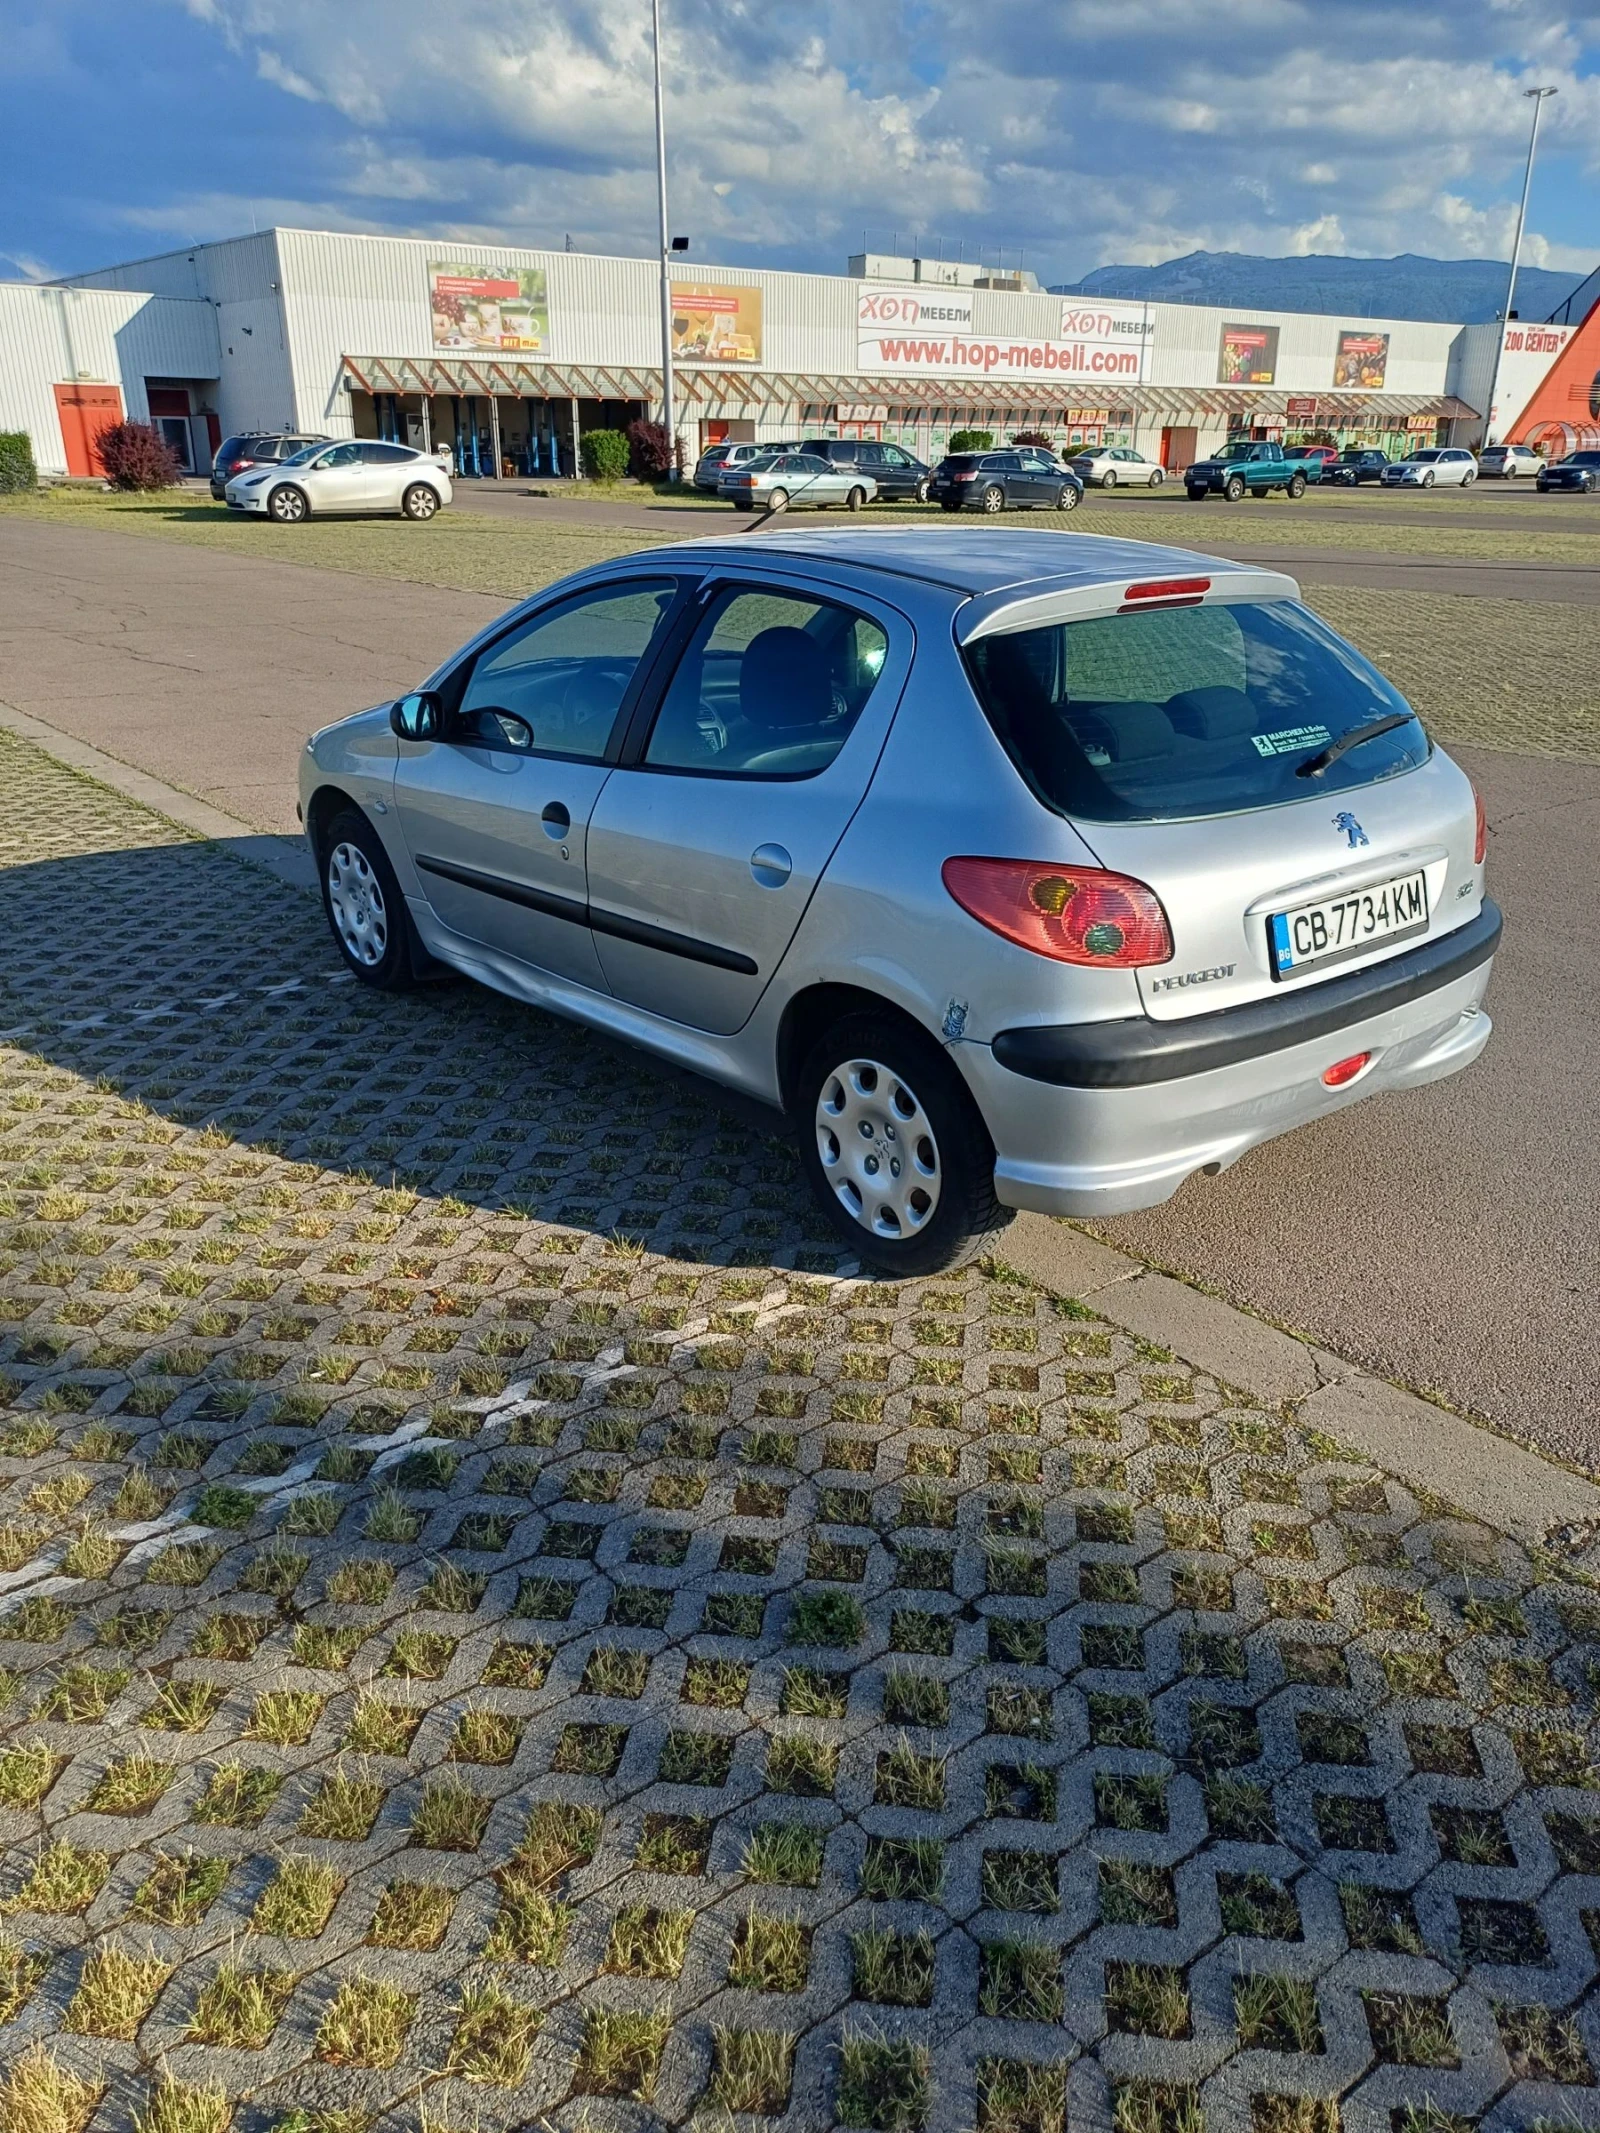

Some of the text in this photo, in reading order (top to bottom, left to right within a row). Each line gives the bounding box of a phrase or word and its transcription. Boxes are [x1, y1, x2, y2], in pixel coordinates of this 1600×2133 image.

[860, 295, 971, 325] ХОП МЕБЕЛИ
[1063, 311, 1155, 338] ХОП МЕБЕЛИ
[879, 336, 1138, 374] www.hop-mebeli.com
[1504, 331, 1559, 353] ZOO CENTER
[843, 409, 883, 417] САЛИ
[1268, 728, 1305, 741] MARCHER
[1307, 725, 1327, 733] Sohn
[1293, 880, 1422, 956] CB 7734 KM
[1278, 948, 1291, 962] BG
[1153, 963, 1237, 993] PEUGEOT
